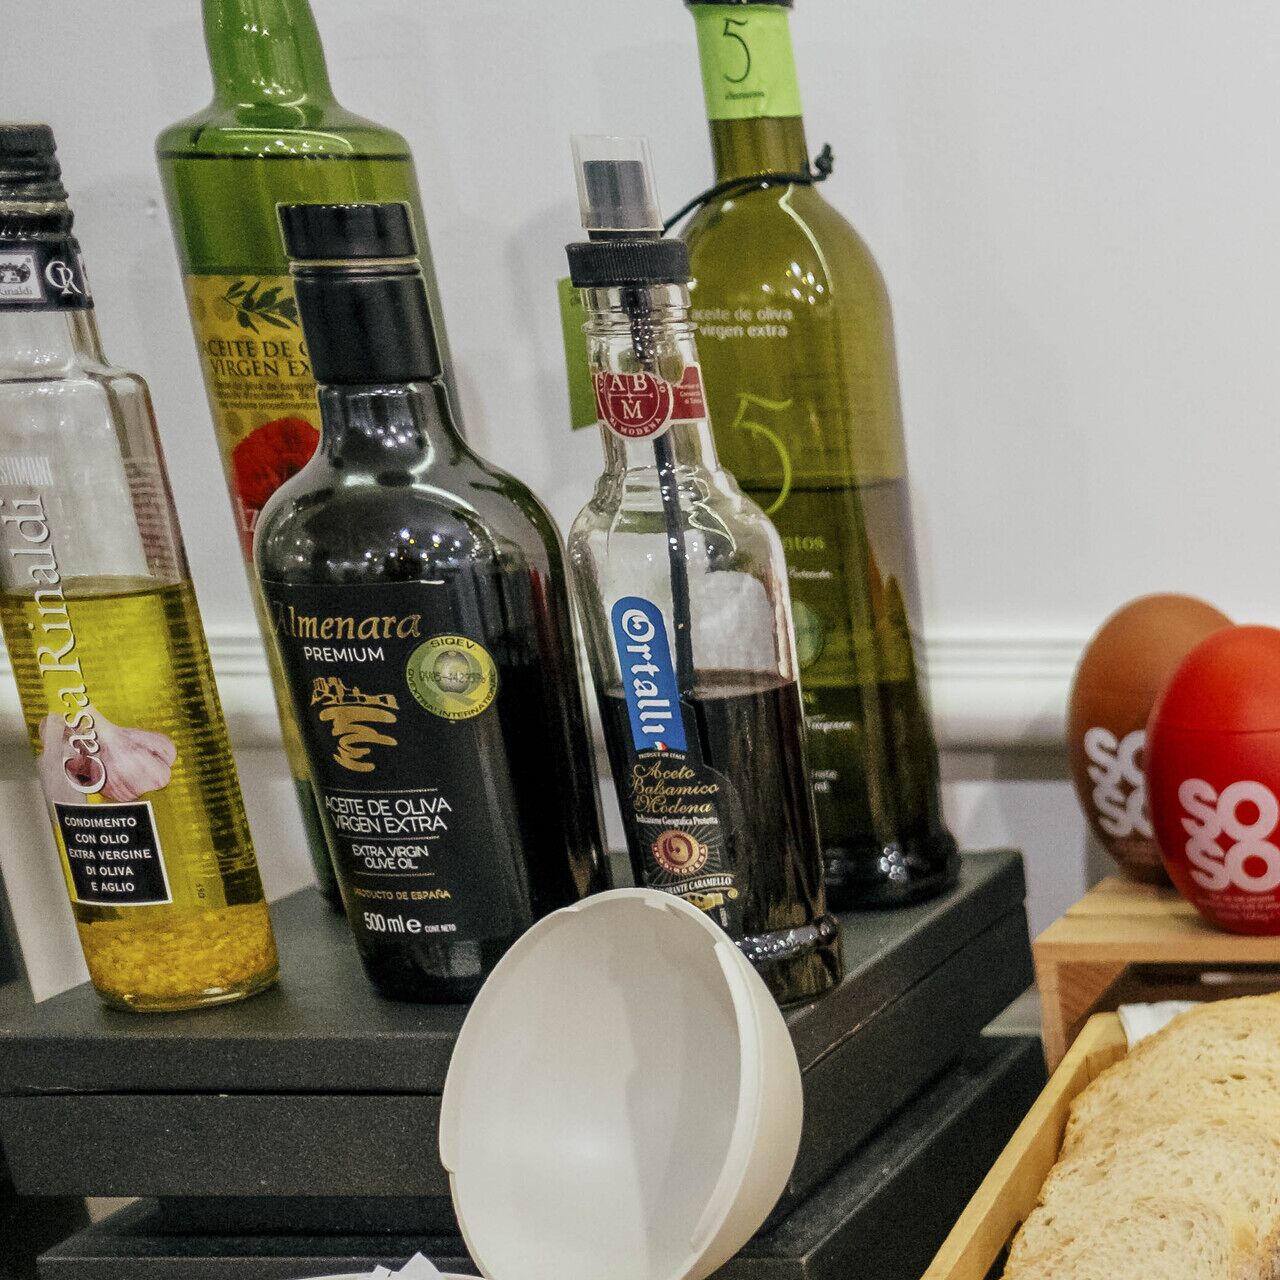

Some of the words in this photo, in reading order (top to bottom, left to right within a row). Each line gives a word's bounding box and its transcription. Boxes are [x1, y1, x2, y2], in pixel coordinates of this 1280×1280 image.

[723, 18, 751, 83] 5
[734, 308, 752, 322] de
[756, 308, 793, 321] oliva
[700, 325, 744, 341] virgen
[747, 326, 788, 337] extra
[263, 341, 291, 357] DE
[210, 360, 279, 377] VIRGEN
[0, 495, 85, 679] Rinaldi
[430, 638, 475, 650] SIQEV
[303, 646, 385, 662] PREMIUM
[58, 683, 107, 794] Casa
[633, 760, 695, 779] Aceto
[631, 777, 719, 796] Balsamico
[325, 796, 366, 815] ACEITE
[367, 799, 393, 816] DE
[395, 797, 452, 816] OLIVA
[1178, 778, 1280, 841] SO
[64, 816, 137, 828] CONDIMENTO
[331, 813, 381, 833] VIRGEN
[383, 815, 448, 833] EXTRA
[75, 833, 97, 844] CON
[100, 834, 130, 844] OLIO
[69, 848, 96, 860] EXTRA
[98, 848, 152, 860] VERGINE
[352, 844, 387, 857] EXTRA
[387, 845, 429, 857] VIRGIN
[86, 865, 96, 876] DI
[99, 866, 134, 876] OLIVA
[364, 857, 396, 869] OLIVE
[397, 858, 419, 869] OIL
[91, 882, 98, 892] E
[101, 882, 135, 892] AGLIO
[688, 876, 733, 891] CARAMELLO
[396, 891, 409, 900] DE
[411, 889, 452, 900] ESPAÑA
[363, 912, 386, 932] 500
[387, 914, 406, 933] ml
